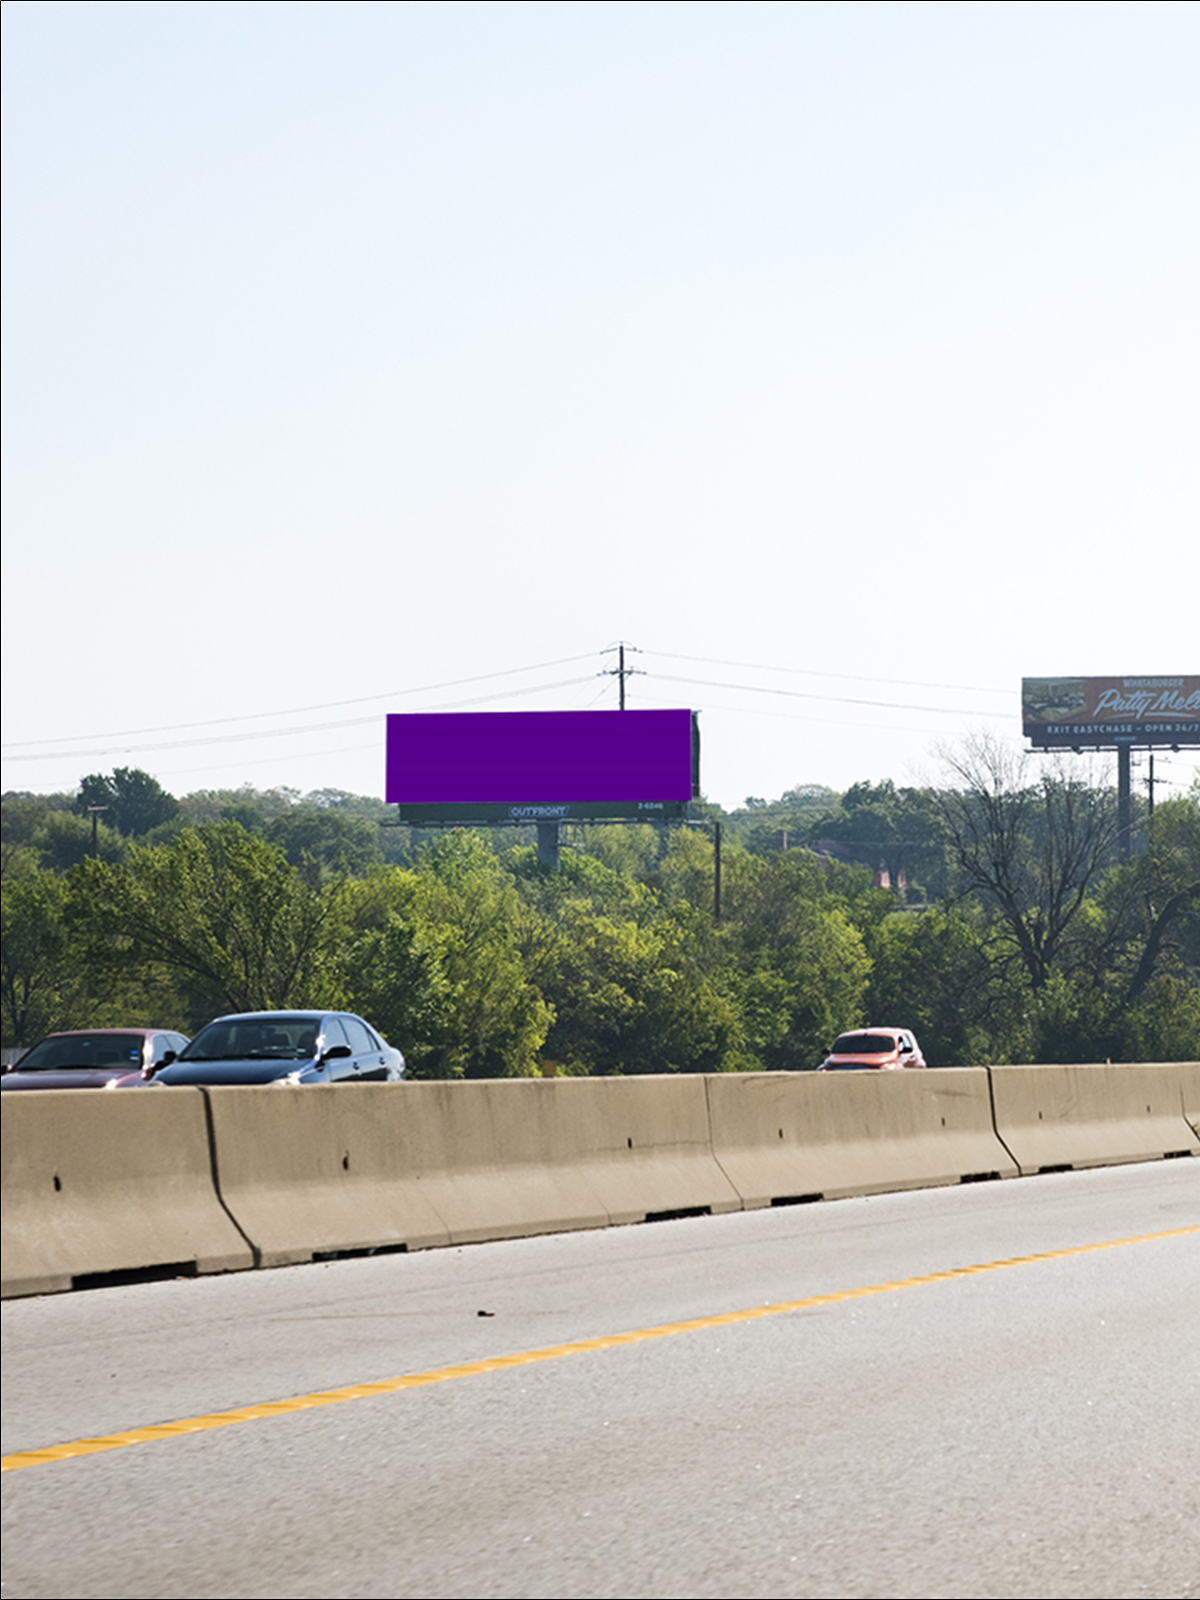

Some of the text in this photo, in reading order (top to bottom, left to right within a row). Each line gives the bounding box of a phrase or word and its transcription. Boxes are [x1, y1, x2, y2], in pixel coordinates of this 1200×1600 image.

[1123, 678, 1184, 687] WHATABURGER
[1092, 688, 1158, 719] Patty
[1047, 725, 1070, 734] EXIT
[1073, 724, 1132, 734] EASTCHASE
[1144, 724, 1173, 732] OPEN
[1175, 723, 1200, 732] 24/7
[511, 806, 566, 816] OUTFRONT
